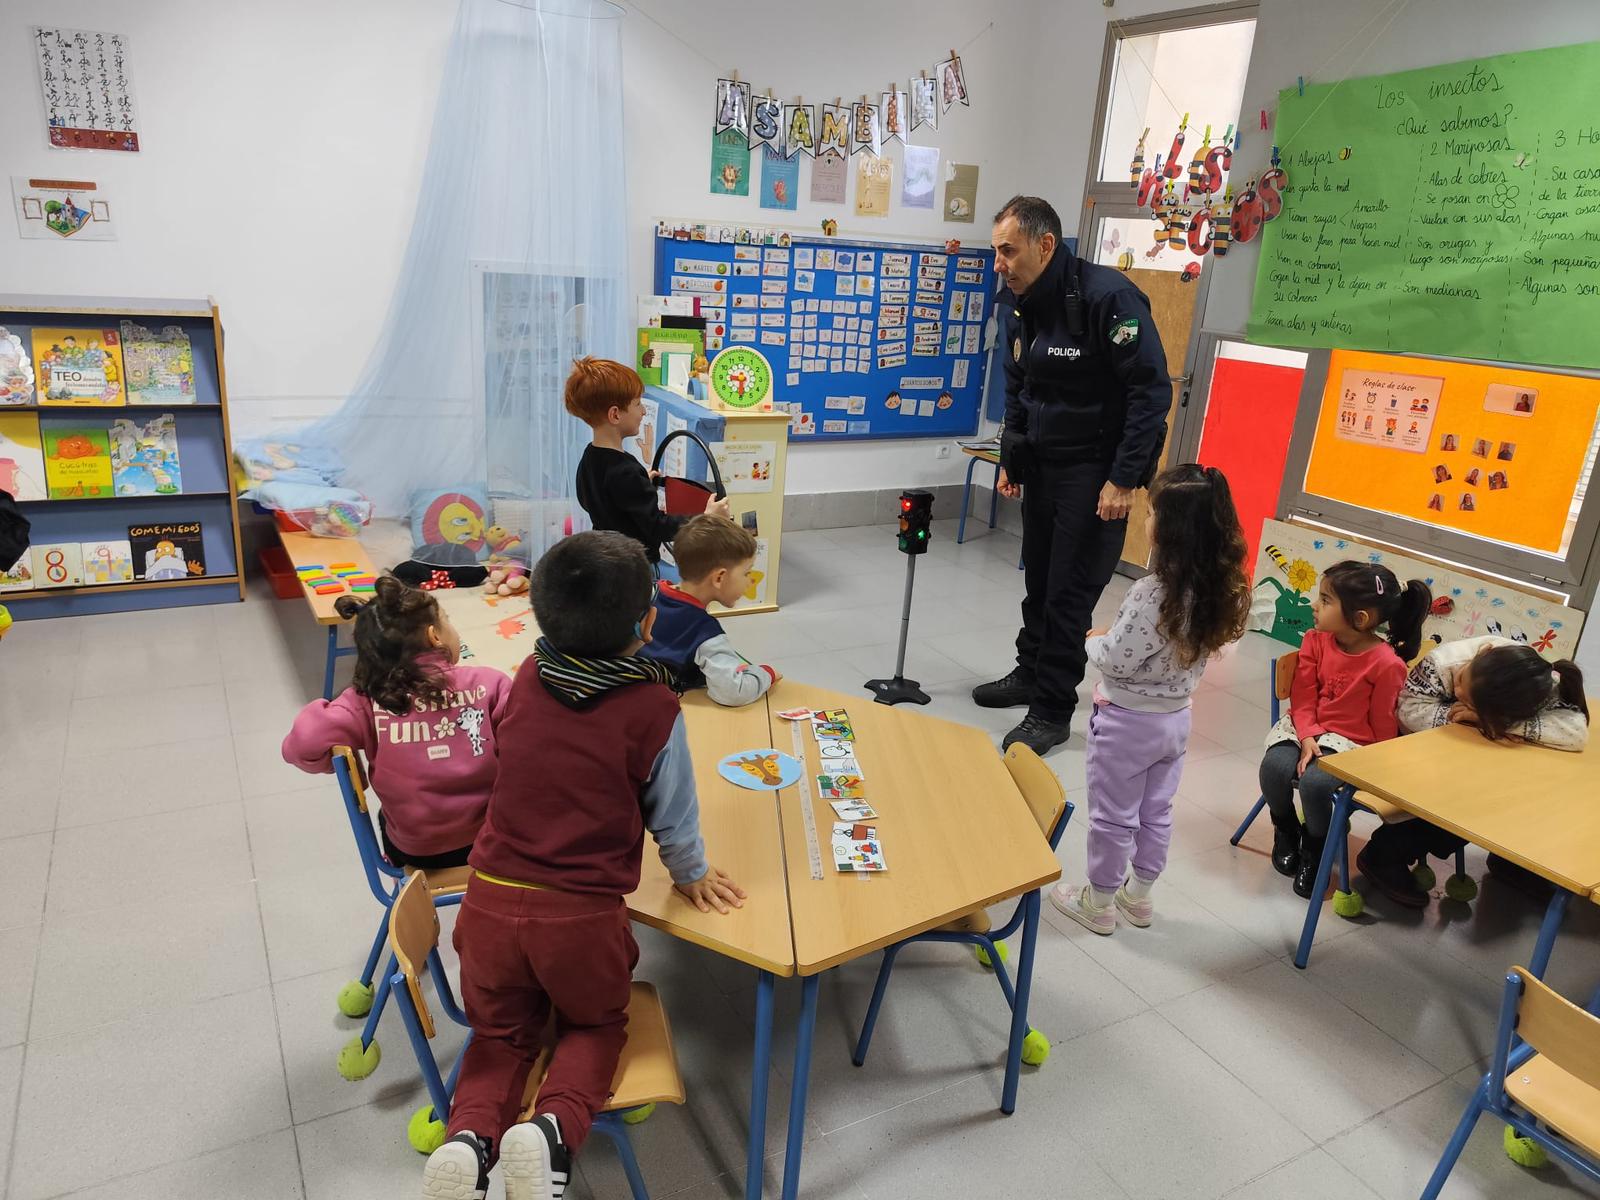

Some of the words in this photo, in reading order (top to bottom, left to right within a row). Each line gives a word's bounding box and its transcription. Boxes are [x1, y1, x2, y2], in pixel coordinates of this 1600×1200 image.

[1377, 83, 1405, 109] Los
[1428, 64, 1504, 100] insectos
[718, 63, 967, 149] ASAMBLEA
[1555, 129, 1567, 147] 3
[1430, 141, 1438, 156] 2
[1445, 137, 1515, 167] Mariposas
[1297, 150, 1335, 176] Abejas
[1552, 165, 1568, 181] Su
[1429, 170, 1447, 186] Alas
[1451, 166, 1463, 184] de
[1299, 177, 1320, 202] gusta
[1323, 176, 1333, 192] la
[1336, 178, 1350, 192] miel
[1538, 190, 1551, 200] de
[1557, 187, 1567, 200] la
[1426, 193, 1436, 203] Se
[1442, 195, 1470, 211] posan
[1476, 195, 1490, 204] en
[1286, 207, 1308, 224] Tienen
[1313, 215, 1337, 233] rayas
[1420, 212, 1449, 225] Vuelan
[1453, 214, 1467, 223] con
[1473, 213, 1493, 224] sus
[1496, 208, 1521, 224] alas
[1350, 219, 1377, 236] Negras
[1280, 228, 1298, 240] Usan
[1301, 231, 1312, 242] las
[1315, 233, 1334, 252] flores
[1339, 237, 1356, 253] para
[1361, 234, 1381, 247] hacer
[1383, 235, 1401, 249] miel
[1418, 236, 1433, 250] Son
[1439, 239, 1477, 259] orugas
[1486, 240, 1494, 255] y
[1530, 230, 1574, 250] Algunas
[1295, 259, 1303, 267] en
[1439, 255, 1459, 264] son
[1461, 255, 1509, 272] mariposas
[1523, 251, 1544, 265] Son
[1293, 271, 1300, 284] la
[1305, 274, 1320, 285] miel
[1325, 278, 1333, 295] y
[1338, 274, 1345, 289] la
[1375, 281, 1387, 290] en
[1402, 280, 1421, 294] Son
[1425, 281, 1482, 300] medianas
[1520, 276, 1567, 305] Algunas
[1575, 283, 1600, 296] son
[1287, 314, 1306, 331] alas
[1311, 321, 1317, 336] y
[1321, 310, 1352, 335] antenas
[1047, 346, 1081, 357] POLICIA
[54, 371, 82, 382] TEO
[1362, 378, 1386, 390] Reglas
[1387, 381, 1395, 389] de
[1397, 382, 1416, 392] clase
[46, 550, 68, 583] 8
